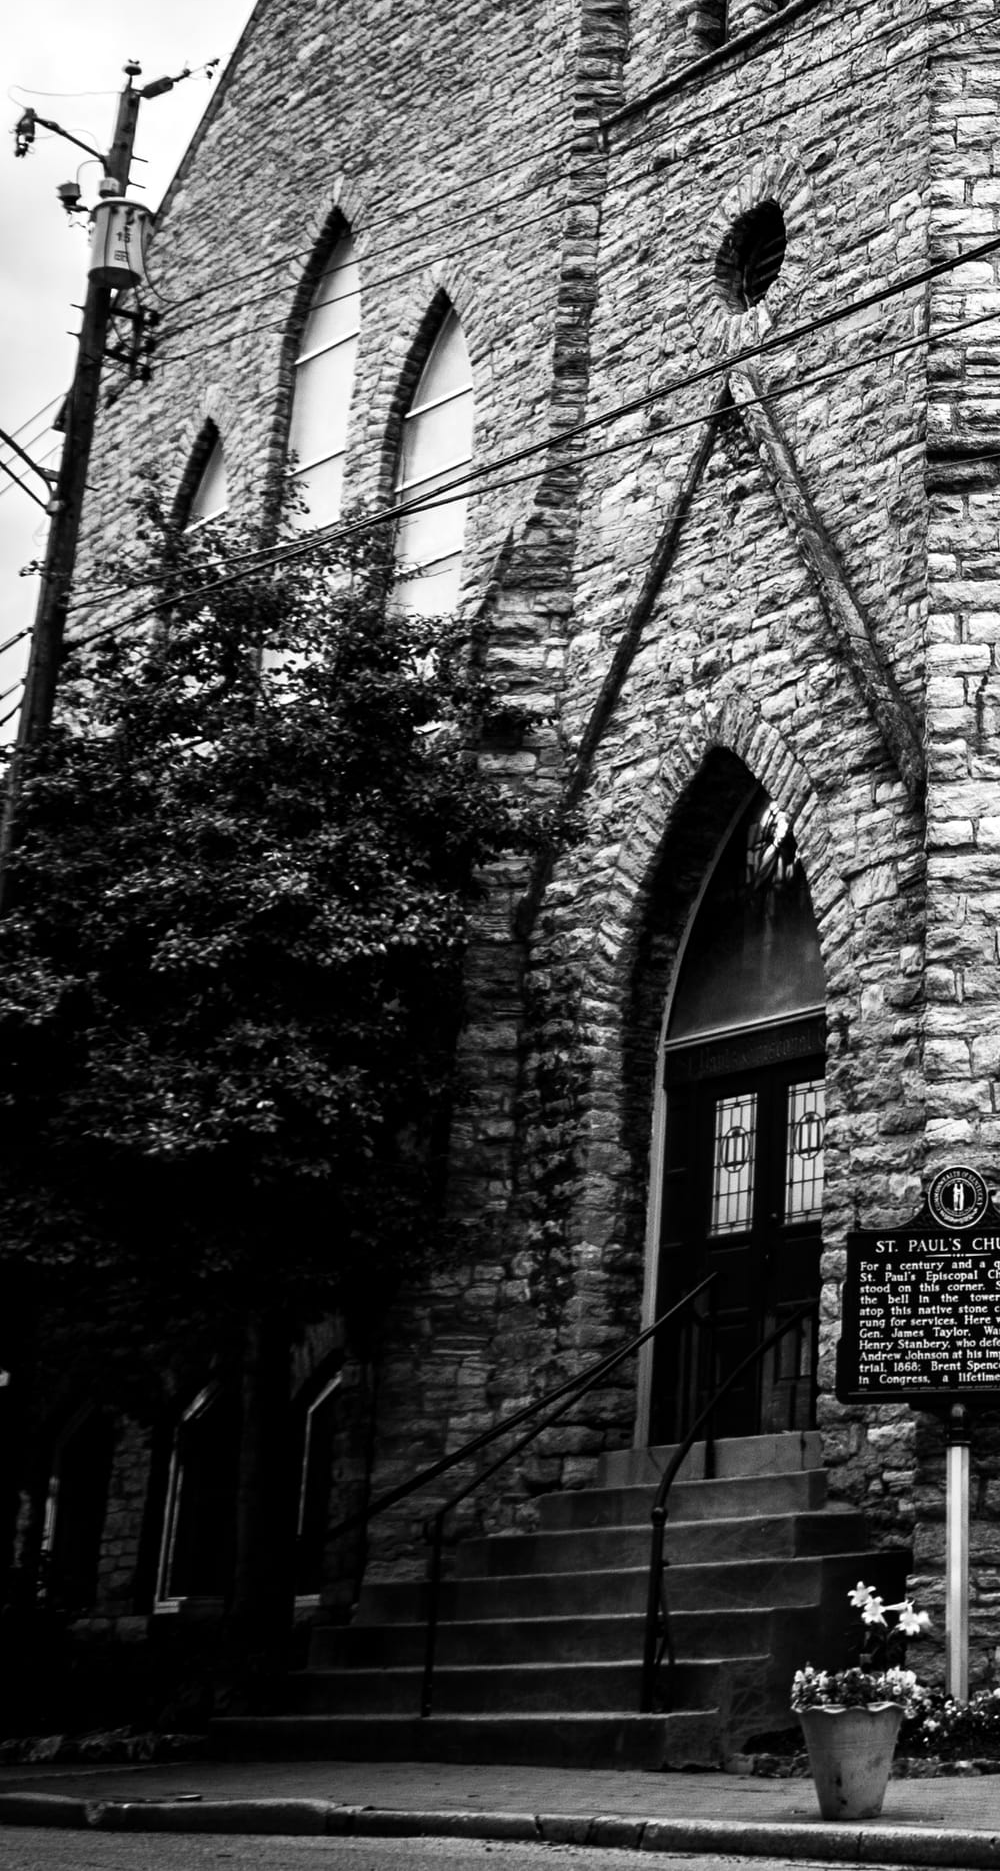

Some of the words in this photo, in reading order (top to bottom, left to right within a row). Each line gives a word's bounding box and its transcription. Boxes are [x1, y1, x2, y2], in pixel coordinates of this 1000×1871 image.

[874, 1240, 899, 1253] ST.
[908, 1238, 962, 1252] PAUL'S
[859, 1261, 880, 1271] For
[885, 1262, 893, 1271] a
[899, 1261, 945, 1270] century
[951, 1259, 973, 1269] and
[978, 1260, 987, 1269] a
[859, 1272, 876, 1282] St.
[884, 1271, 917, 1282] Paul's
[925, 1270, 979, 1281] Episcopal
[859, 1283, 891, 1293] stood
[897, 1284, 912, 1293] on
[918, 1281, 941, 1292] this
[946, 1280, 986, 1291] corner.
[859, 1295, 878, 1305] the
[887, 1294, 910, 1304] bell
[918, 1293, 930, 1304] in
[940, 1293, 960, 1303] the
[859, 1307, 885, 1317] atop
[890, 1306, 912, 1315] this
[917, 1305, 953, 1315] native
[957, 1305, 989, 1315] stone
[859, 1317, 887, 1328] rung
[889, 1317, 908, 1326] for
[910, 1316, 958, 1326] services.
[963, 1314, 992, 1325] Here
[858, 1328, 884, 1338] Gen.
[890, 1328, 925, 1338] James
[858, 1340, 895, 1351] Henry
[955, 1338, 977, 1347] who
[859, 1351, 902, 1361] Andrew
[904, 1350, 950, 1360] Johnson
[951, 1349, 963, 1360] at
[965, 1349, 983, 1359] his
[930, 1361, 962, 1371] Brent
[858, 1375, 870, 1385] in
[941, 1374, 949, 1383] a
